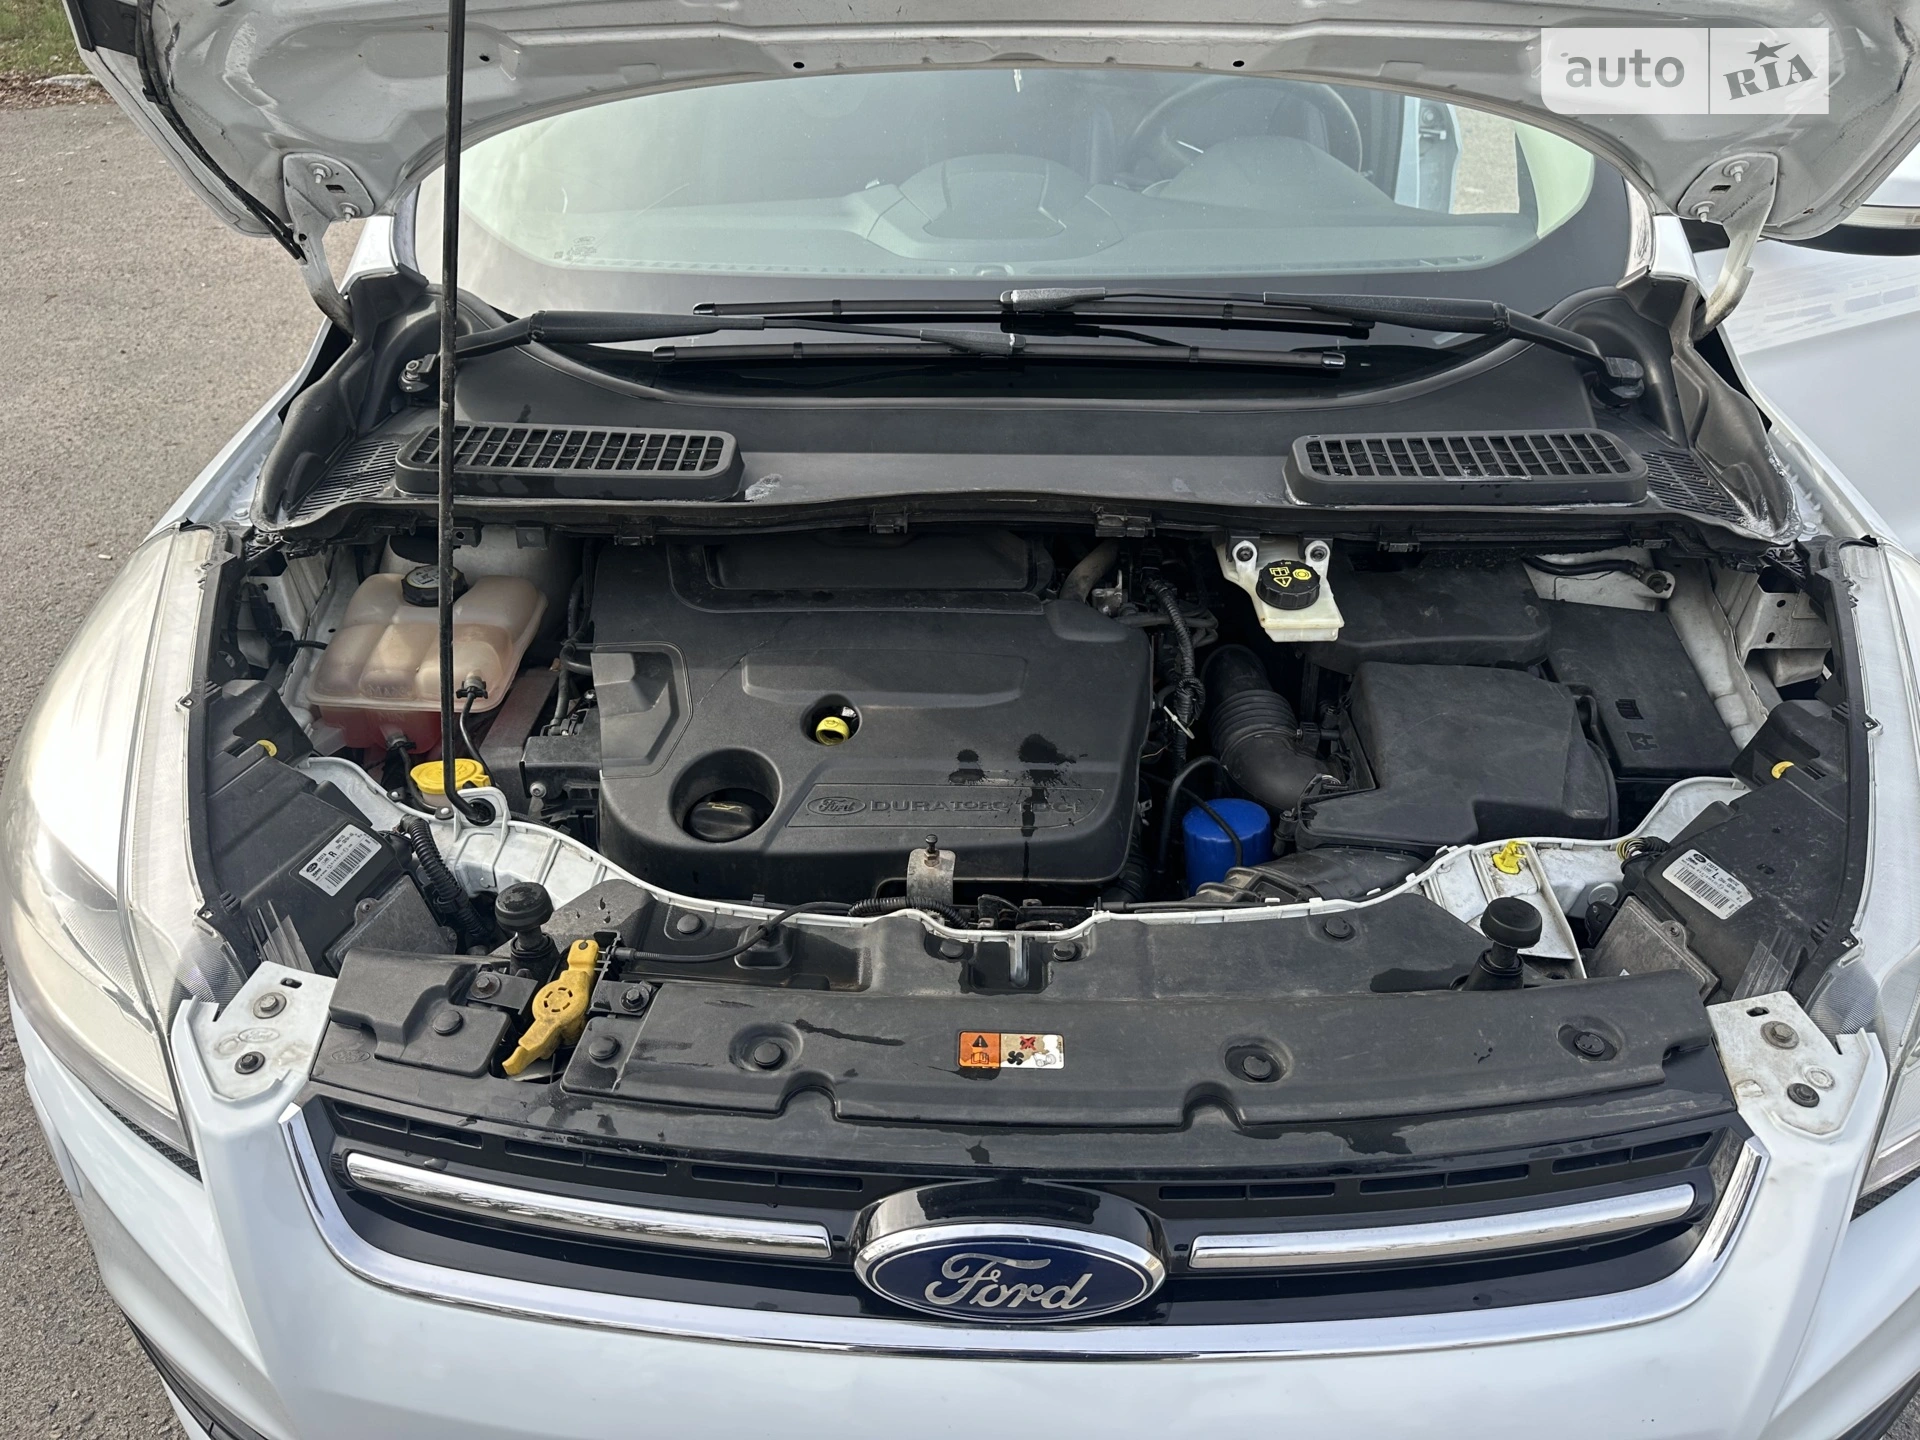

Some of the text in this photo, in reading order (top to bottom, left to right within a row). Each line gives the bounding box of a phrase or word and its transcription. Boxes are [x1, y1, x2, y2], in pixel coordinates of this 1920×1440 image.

[818, 799, 857, 812] Ford
[870, 800, 1009, 812] DURATORQ
[925, 1252, 1093, 1310] Ford
